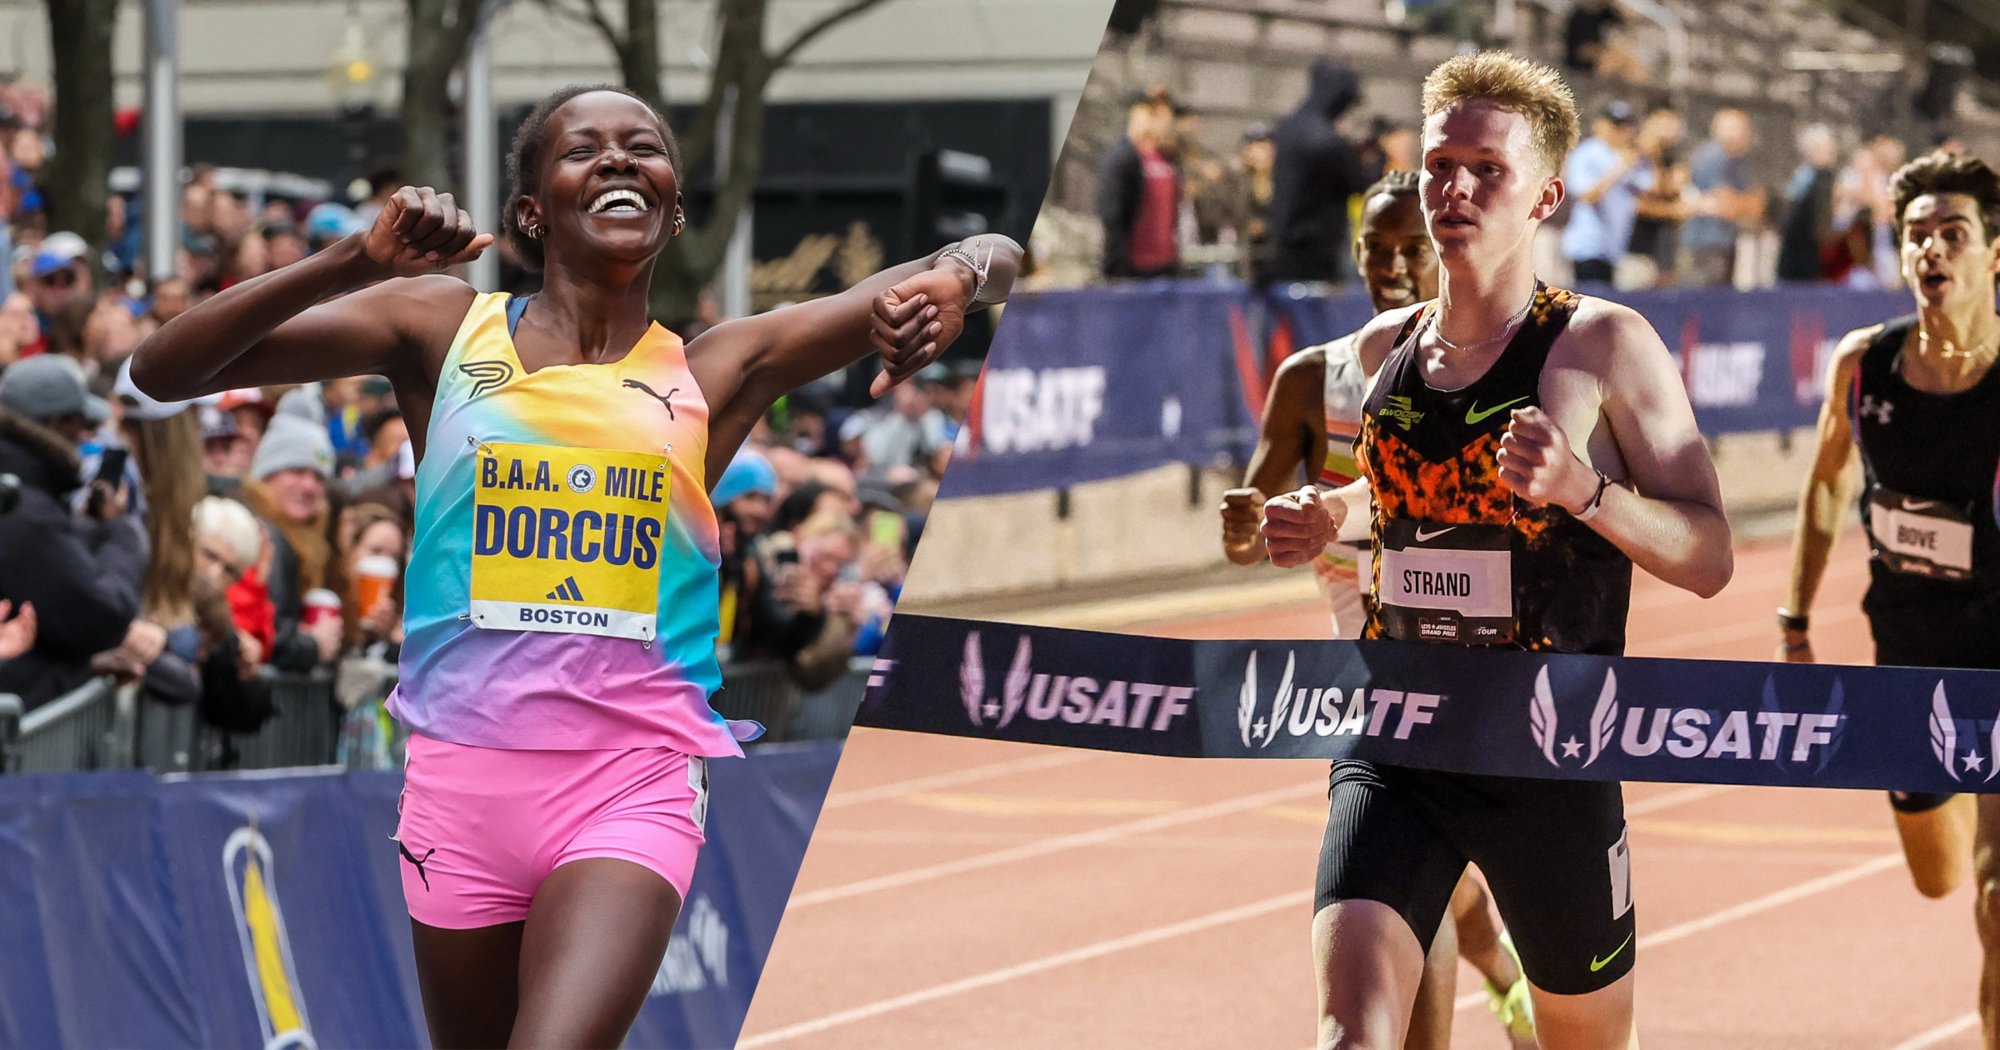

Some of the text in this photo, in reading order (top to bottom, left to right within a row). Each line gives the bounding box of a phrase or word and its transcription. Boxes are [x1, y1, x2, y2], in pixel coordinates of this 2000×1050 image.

[482, 457, 559, 492] B.A.A.
[604, 465, 665, 503] MILE
[474, 504, 662, 570] DORCUS
[1896, 524, 1938, 550] BOVE
[1403, 569, 1471, 597] STRAND
[519, 607, 609, 627] BOSTON
[1025, 674, 1194, 731] USATF
[1288, 687, 1441, 740] USATF
[1620, 707, 1839, 762] USATF
